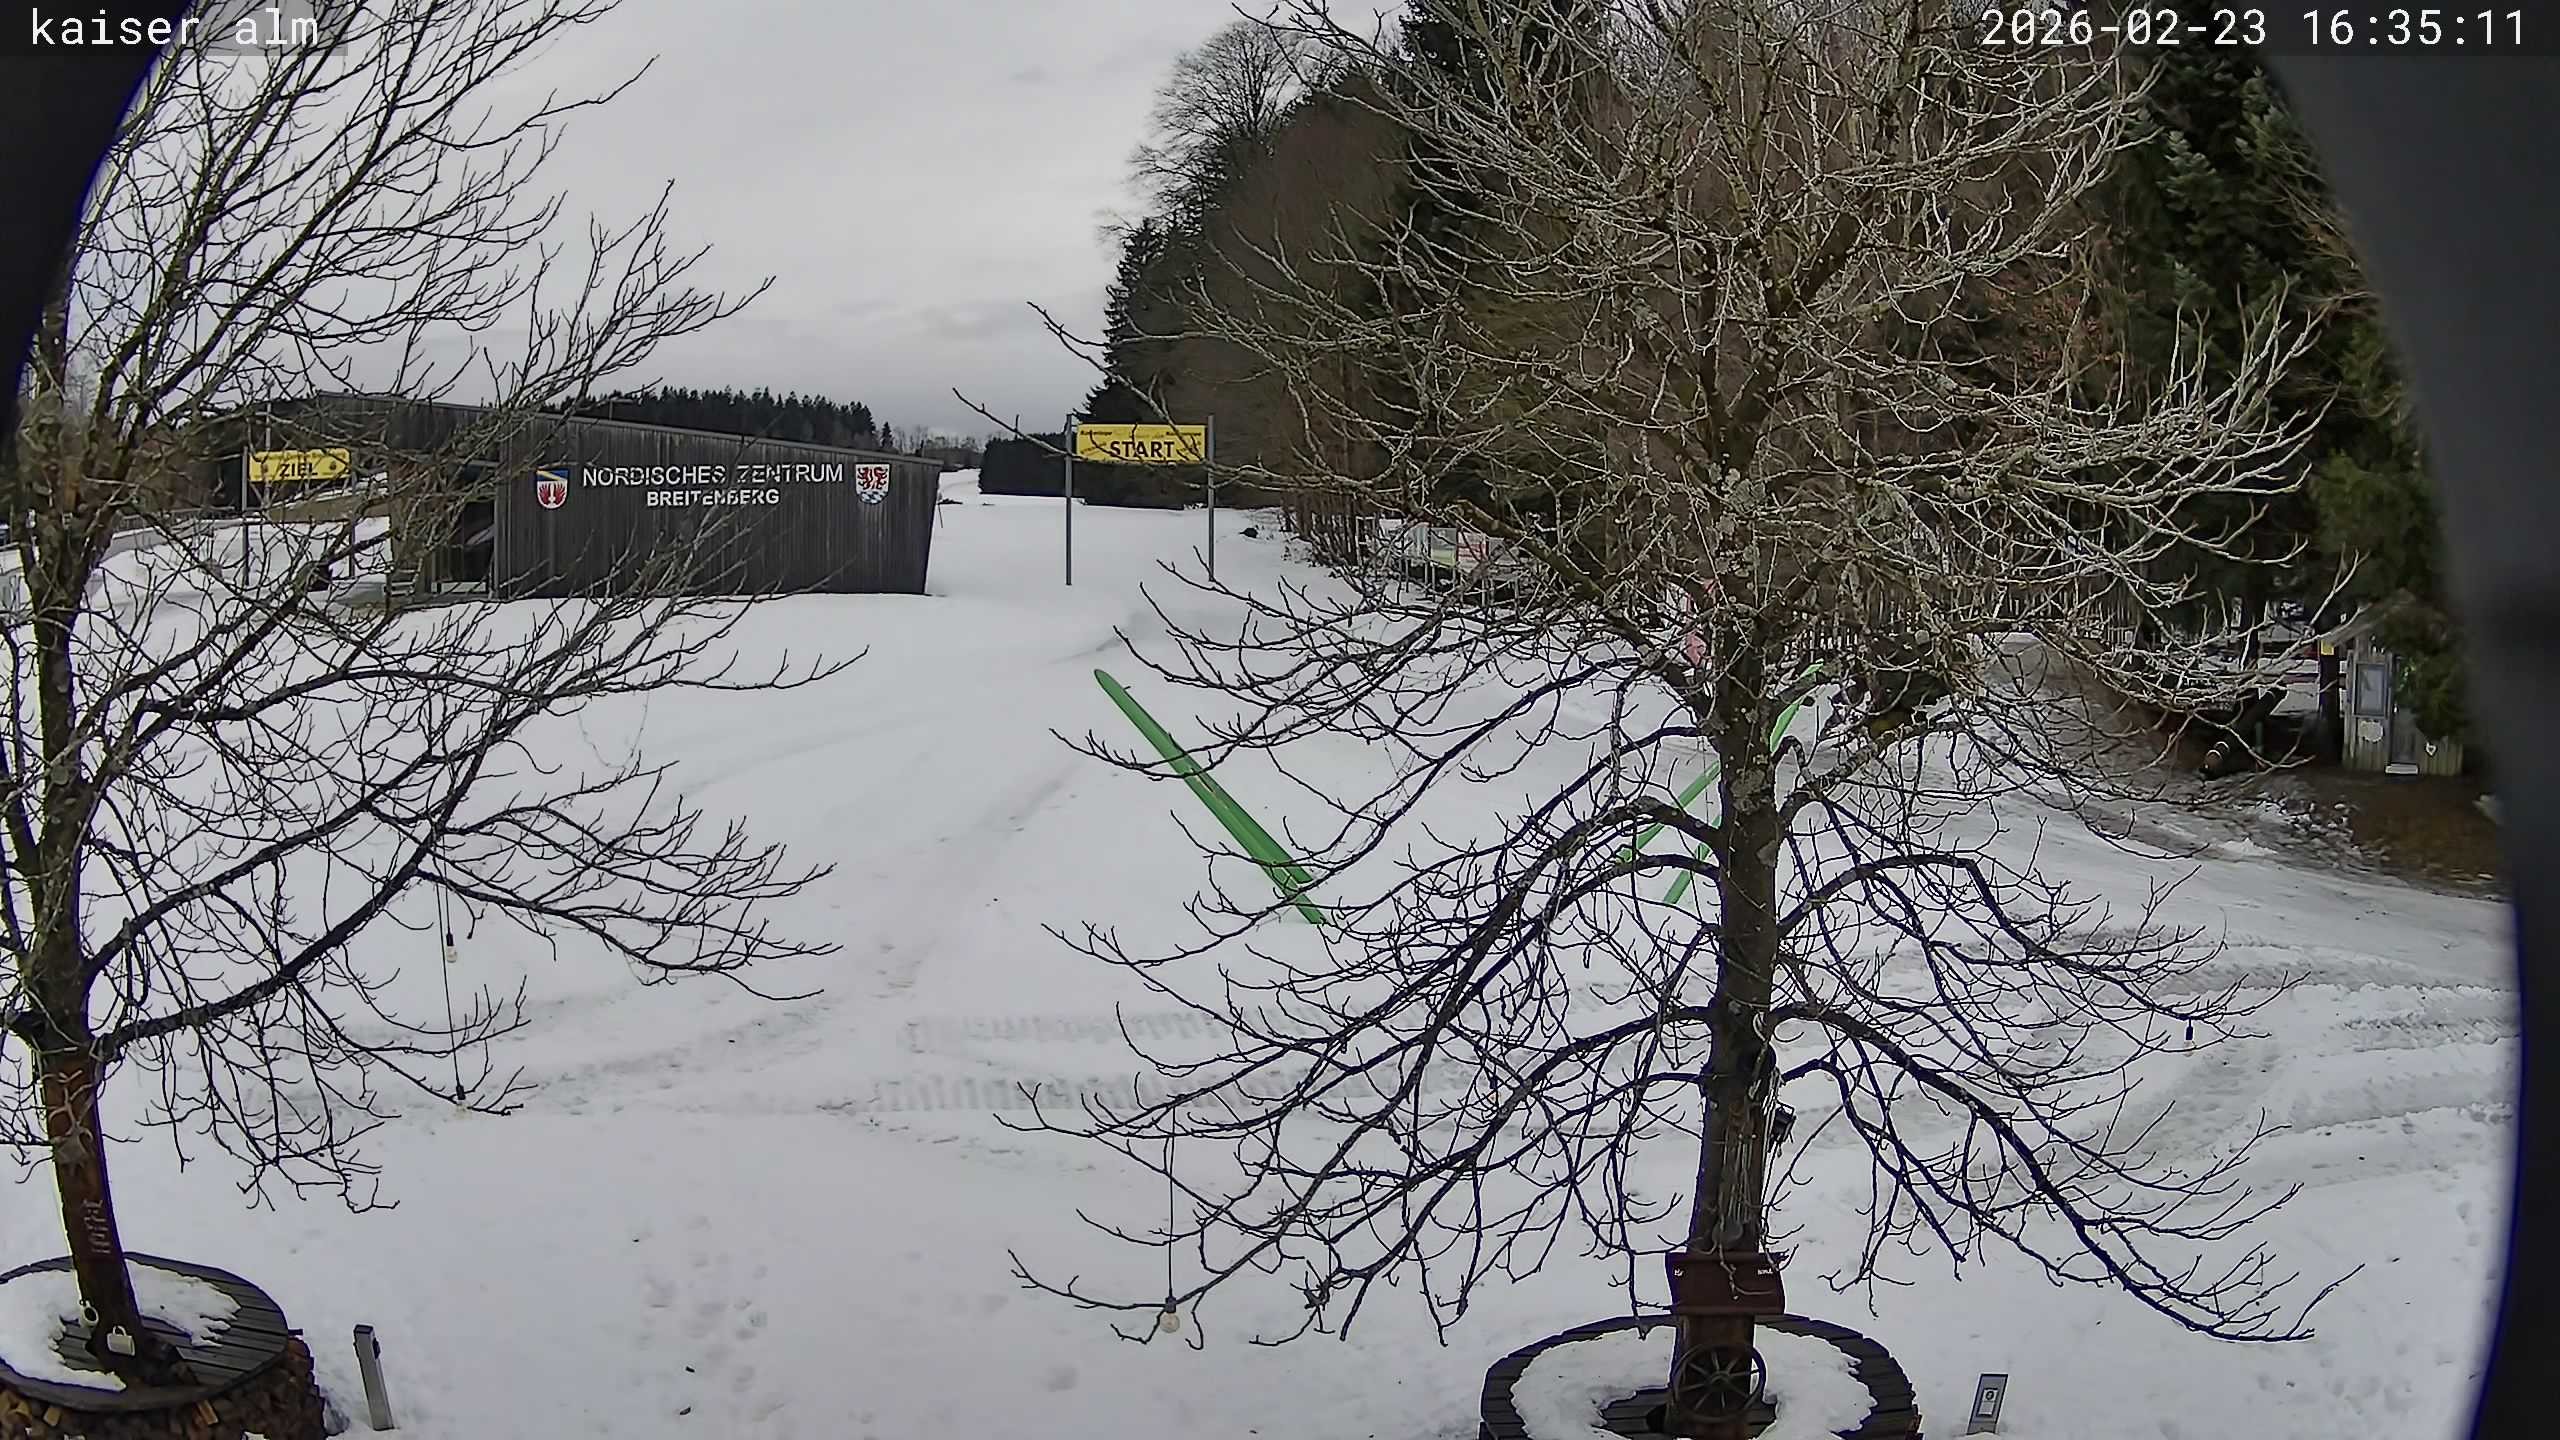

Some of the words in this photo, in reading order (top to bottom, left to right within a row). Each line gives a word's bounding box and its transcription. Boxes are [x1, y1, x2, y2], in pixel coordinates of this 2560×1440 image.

[1110, 441, 1175, 458] START
[279, 463, 318, 477] ZIEL
[583, 465, 726, 488] NORDISCHES
[737, 463, 843, 485] ZENTRUM
[647, 489, 780, 507] BREITENBERG
